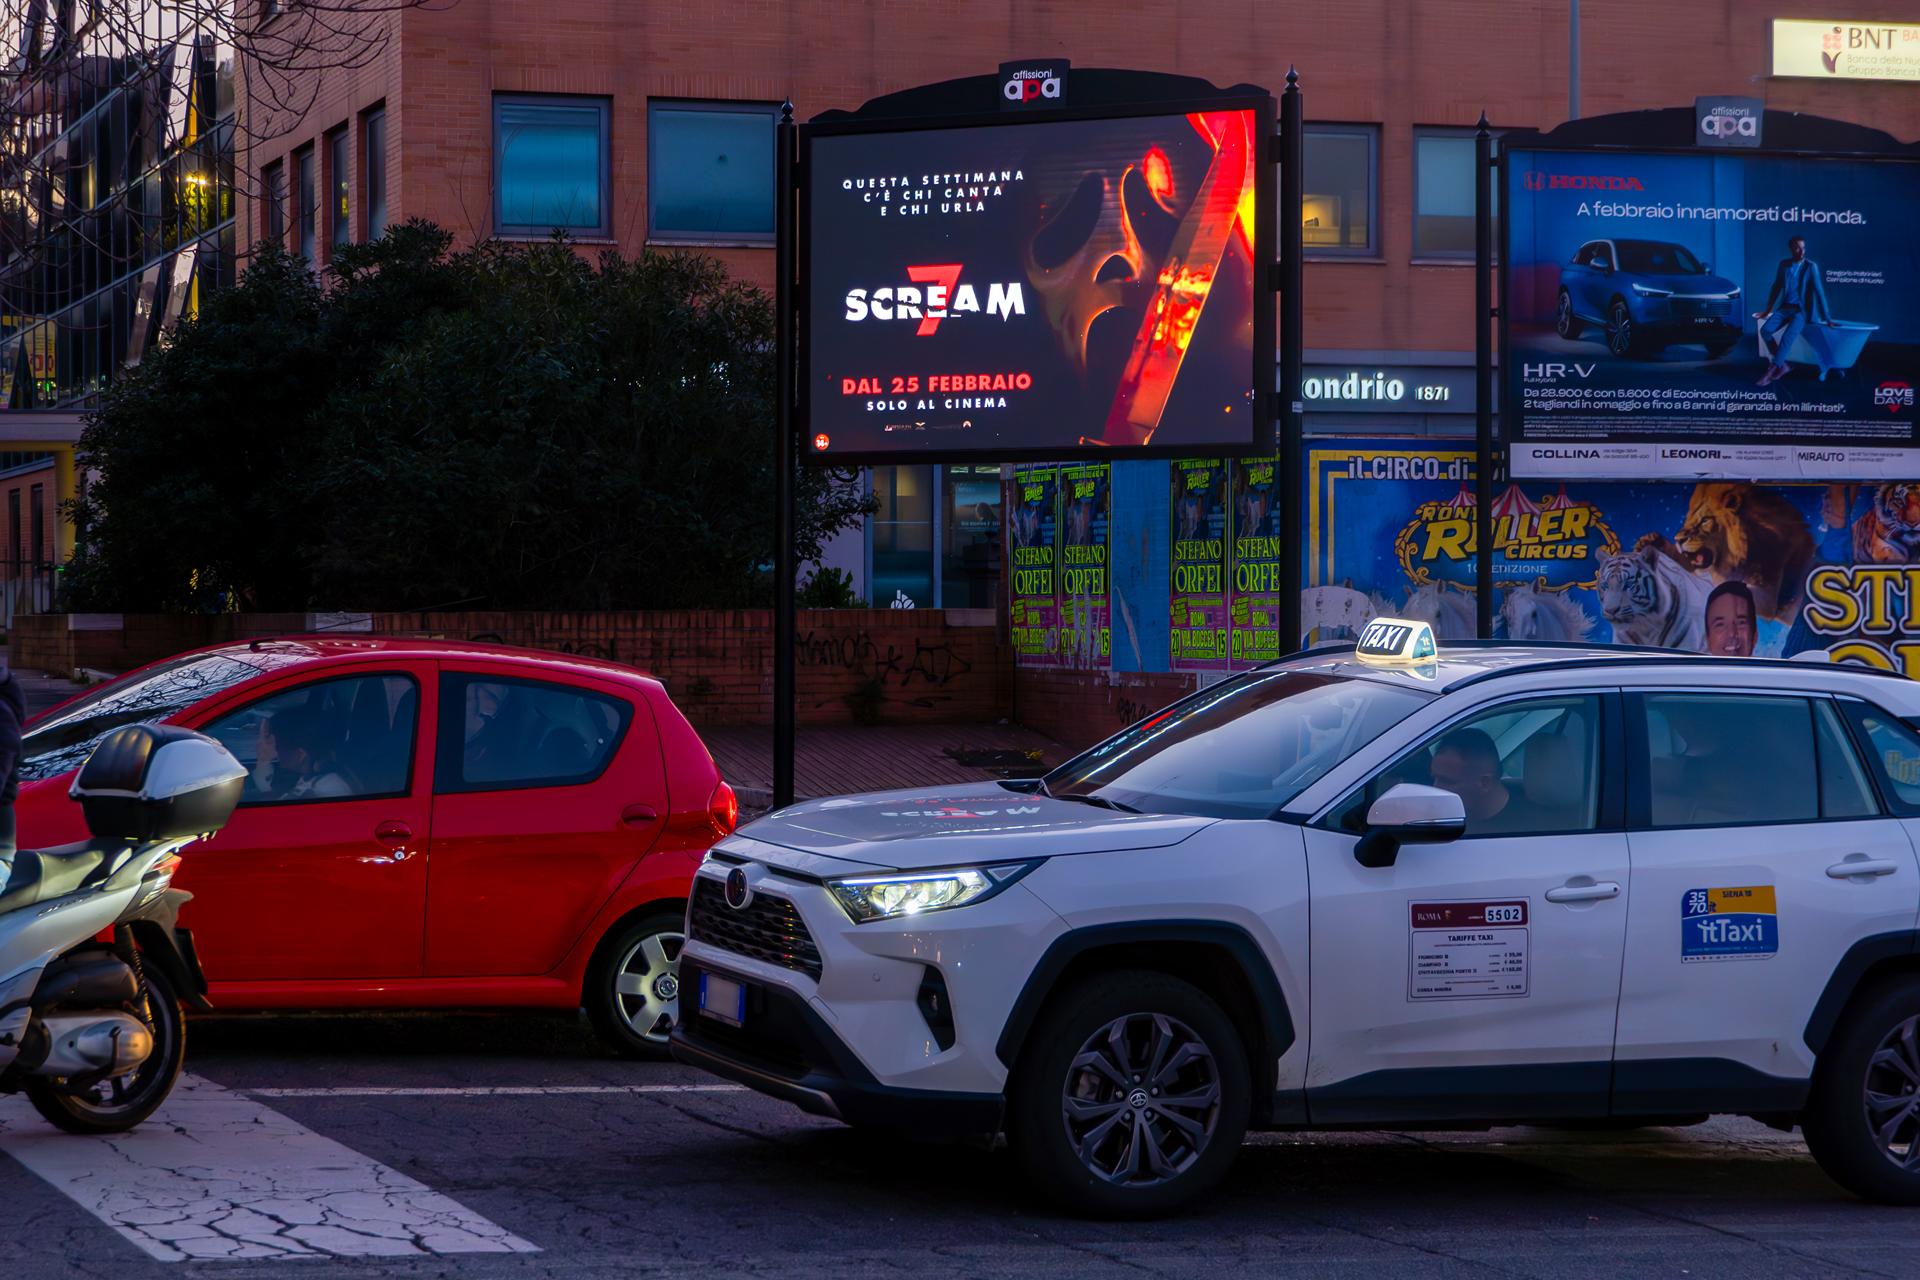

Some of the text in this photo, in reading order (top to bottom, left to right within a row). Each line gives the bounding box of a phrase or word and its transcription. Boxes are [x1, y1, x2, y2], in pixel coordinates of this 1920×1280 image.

[1848, 27, 1897, 49] BNT
[1013, 69, 1052, 79] affissioni
[1004, 78, 1060, 103] apa
[1701, 115, 1756, 139] apa
[843, 171, 1023, 189] QUESTA SETTIMANA
[1550, 175, 1645, 191] HONDA
[864, 186, 1002, 202] C'È CHI CANTA
[881, 202, 984, 216] E CHI URLA
[1577, 201, 1867, 225] A febbraio innamorati di Honda.
[845, 282, 1025, 322] SCREAM
[906, 264, 963, 336] 7
[1524, 363, 1596, 378] HR-V
[842, 373, 1032, 394] DAL 25 FEBBRAIO
[1302, 372, 1449, 400] ondrio 1871
[1874, 388, 1914, 397] LOVE
[867, 397, 1007, 411] SOLO AL CINEMA
[1524, 388, 1539, 397] Da
[1540, 388, 1583, 397] 28.900
[1583, 388, 1592, 397] €
[1662, 388, 1672, 398] di
[1673, 389, 1738, 400] Ecoincentivi
[1739, 391, 1777, 401] Honda,
[1874, 397, 1914, 405] DAYS
[1524, 400, 1532, 408] 2
[1533, 399, 1580, 411] tagliandi
[1581, 399, 1592, 408] in
[1593, 400, 1641, 411] omaggio
[1642, 401, 1650, 409] e
[1652, 399, 1673, 409] fino
[1682, 401, 1691, 410] 8
[1691, 401, 1716, 410] anni
[1716, 401, 1726, 410] di
[1726, 401, 1773, 413] garanzia
[1774, 403, 1781, 411] a
[1782, 402, 1800, 412] km
[1532, 449, 1600, 459] COLLINA
[1661, 449, 1721, 459] LEONORI
[1798, 452, 1845, 462] MIRAUTO
[1349, 456, 1364, 480] il
[1372, 456, 1440, 480] CIRCO
[1448, 458, 1469, 480] di
[1421, 507, 1478, 521] RON
[1015, 547, 1053, 565] STEFANO
[1065, 545, 1105, 564] STEFANO
[1175, 540, 1222, 560] STEFANO
[1236, 537, 1280, 559] STEFAN
[1504, 543, 1588, 559] CIRCUS
[1175, 565, 1221, 592] ORFEI
[1237, 563, 1280, 592] ORFE
[1491, 564, 1548, 574] EDIZIONE
[1015, 569, 1053, 595] ORFEI
[1065, 568, 1105, 595] ORFEI
[1102, 632, 1108, 653] 15
[1172, 632, 1179, 653] 20
[1218, 632, 1226, 654] 15
[1233, 632, 1241, 654] 20
[1362, 625, 1406, 650] TAXI
[1689, 892, 1706, 902] 35
[1417, 912, 1441, 921] ROMA
[1488, 909, 1519, 921] 5502
[1697, 918, 1763, 943] itTaxi
